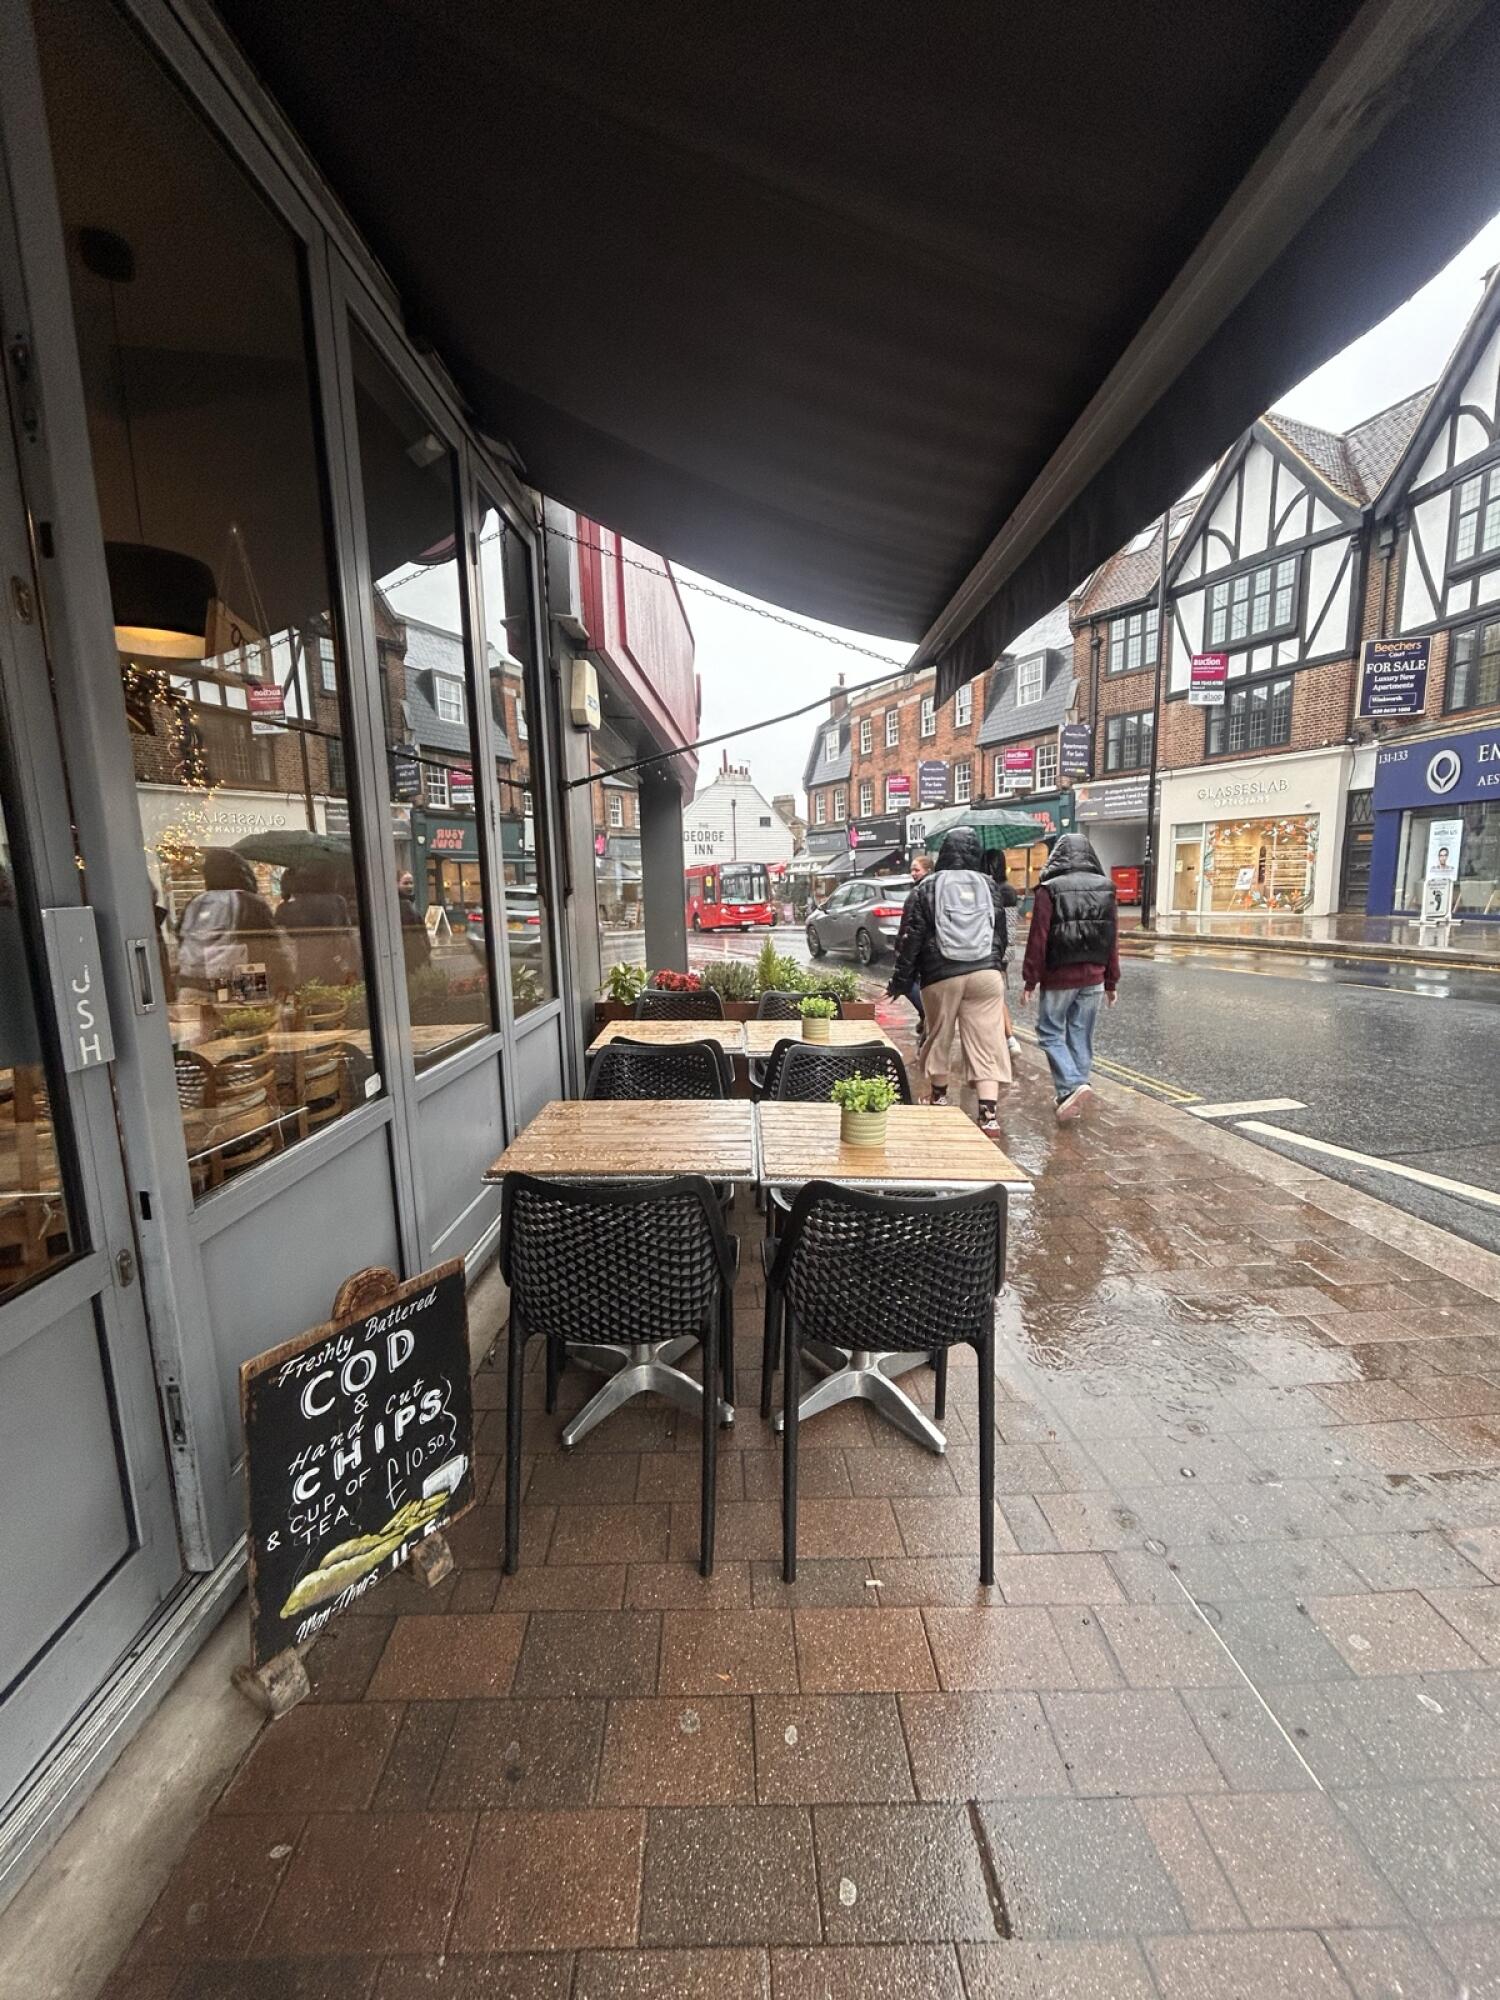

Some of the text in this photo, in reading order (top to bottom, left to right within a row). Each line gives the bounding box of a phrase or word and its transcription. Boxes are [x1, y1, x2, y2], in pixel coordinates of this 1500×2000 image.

[1374, 642, 1422, 652] Beechers
[1193, 656, 1221, 666] auction
[1365, 660, 1427, 674] FOR SALE
[1372, 682, 1415, 692] Apartments
[1378, 749, 1409, 764] 131-133
[1197, 779, 1288, 801] GLASSESLAB
[683, 830, 726, 842] GEORGE
[693, 843, 715, 855] INN
[278, 1286, 437, 1388] Freshly Battered
[300, 1329, 415, 1420] COD
[292, 1389, 442, 1505] CHIPS
[267, 1467, 372, 1551] & CUP OF
[300, 1504, 350, 1545] TEA
